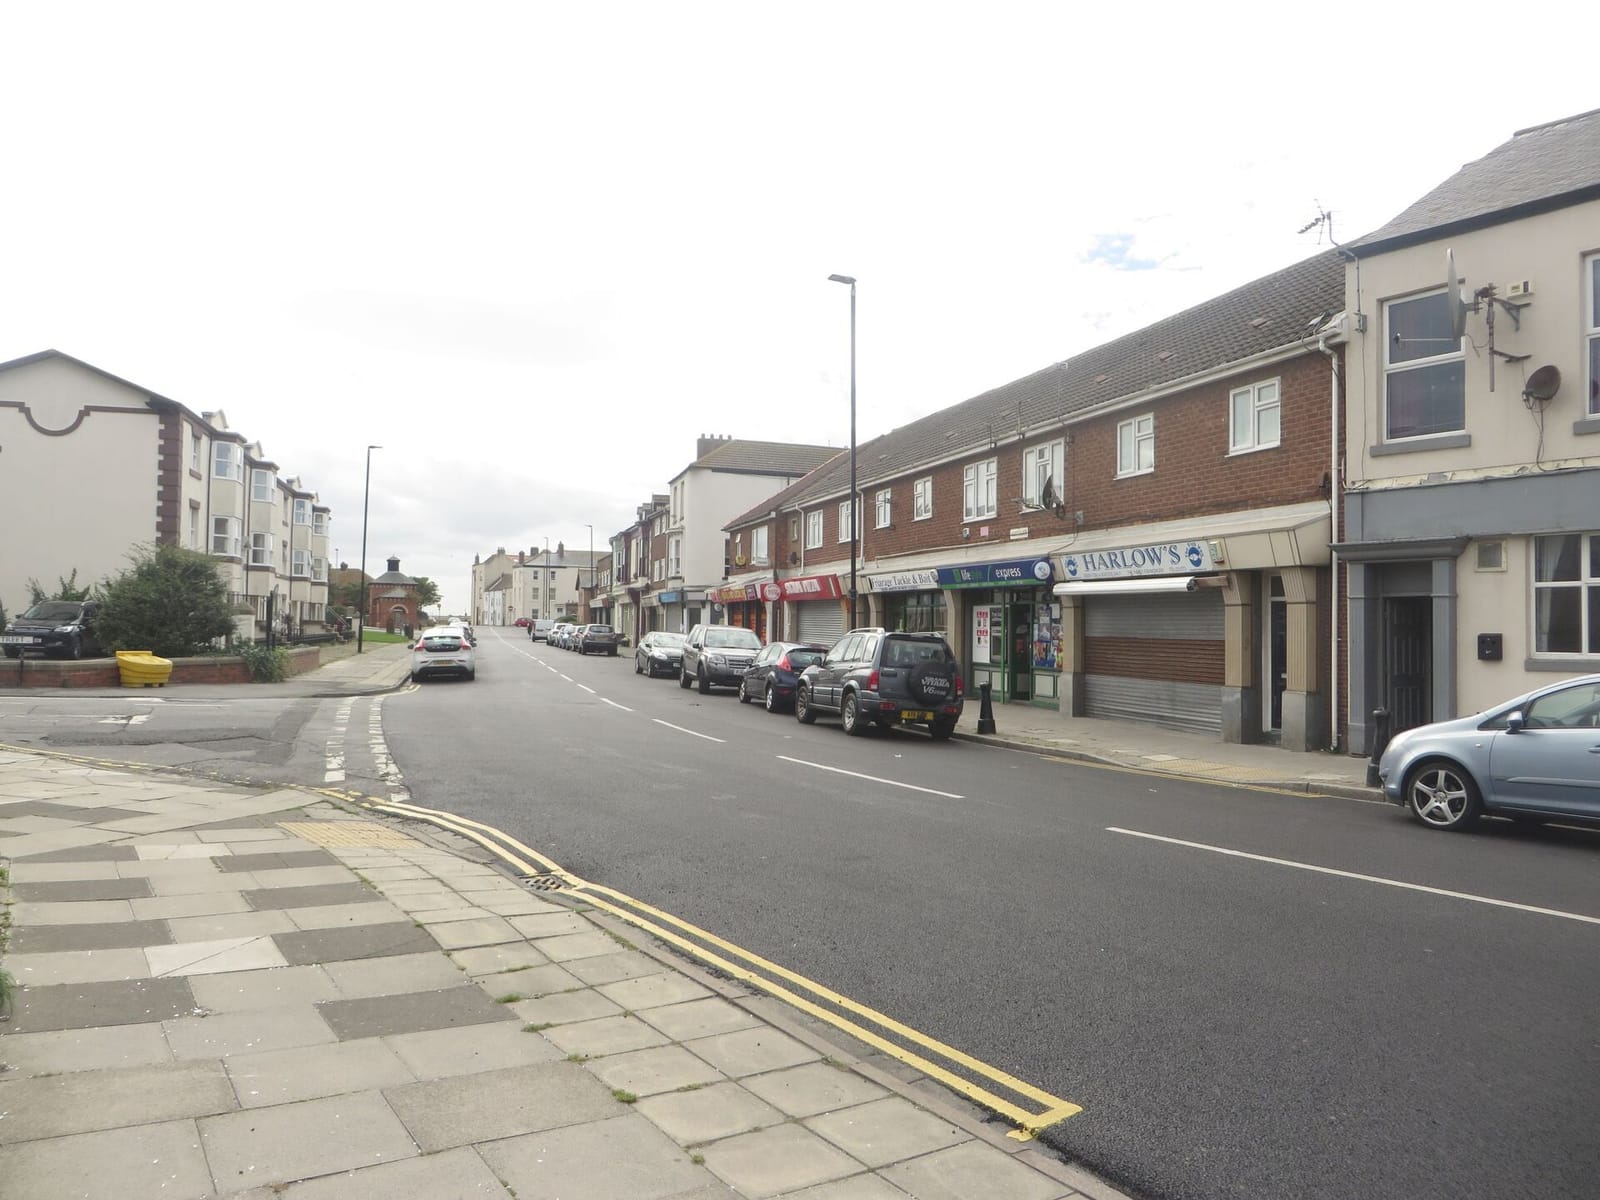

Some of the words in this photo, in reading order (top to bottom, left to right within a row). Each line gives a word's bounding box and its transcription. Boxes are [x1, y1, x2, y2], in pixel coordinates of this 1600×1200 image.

[1082, 545, 1181, 571] HARLOW'S
[995, 567, 1021, 580] express
[923, 685, 935, 694] V6
